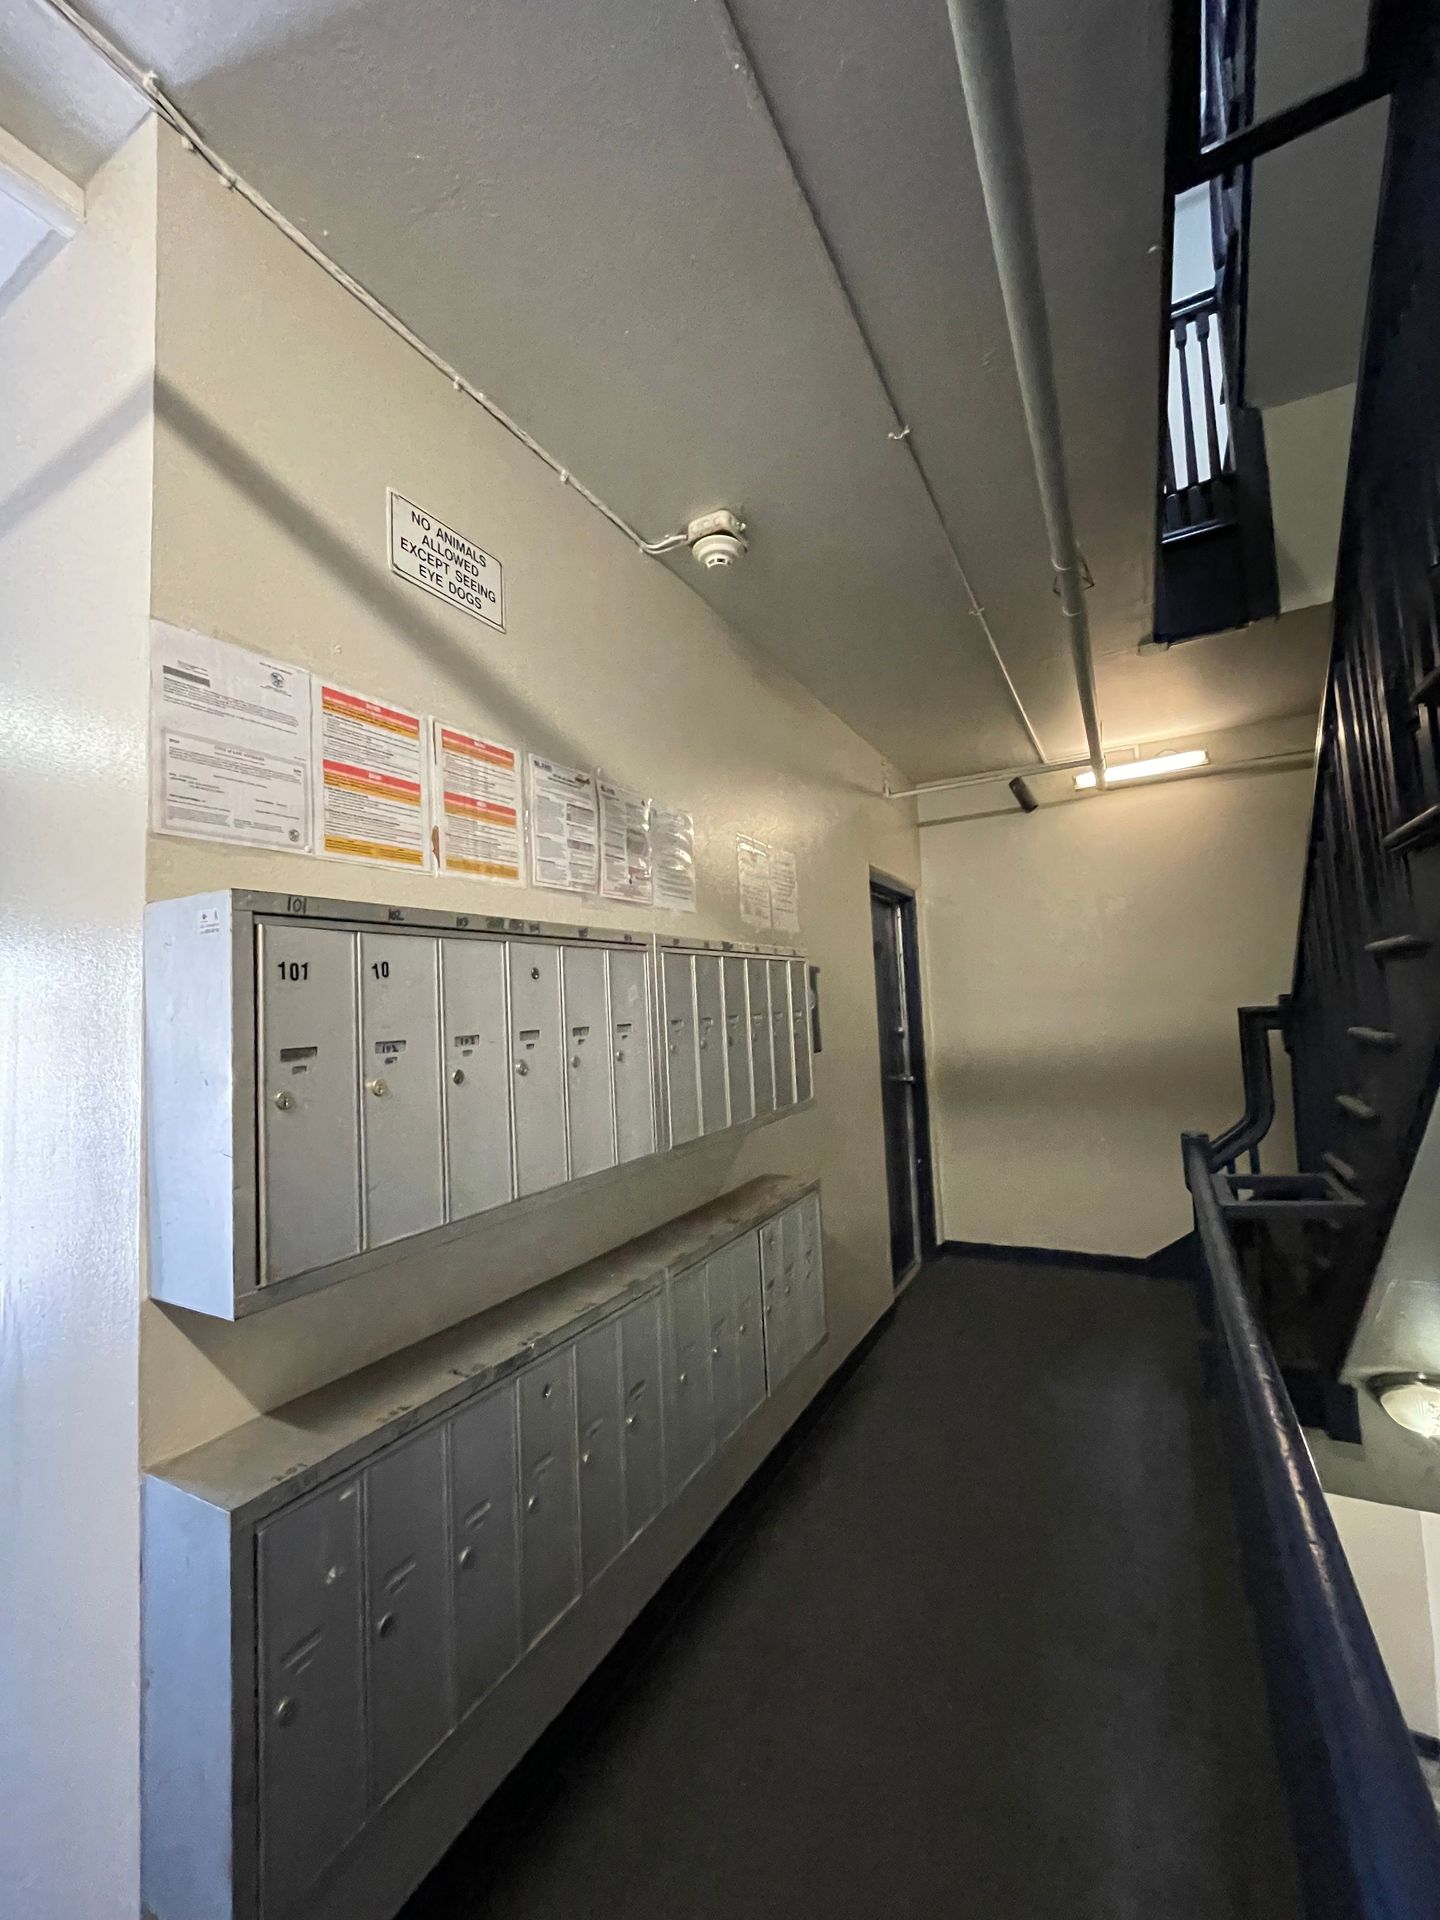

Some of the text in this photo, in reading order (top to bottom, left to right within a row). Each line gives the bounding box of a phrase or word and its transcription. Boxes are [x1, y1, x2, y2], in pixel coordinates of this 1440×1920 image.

[411, 511, 487, 568] NO ANIMALS
[421, 535, 479, 577] ALLOWED
[400, 537, 496, 604] EXCEPT SEEING
[419, 564, 482, 610] EYE DOGS
[287, 897, 307, 914] 101
[277, 961, 309, 981] 101
[372, 961, 389, 980] 10
